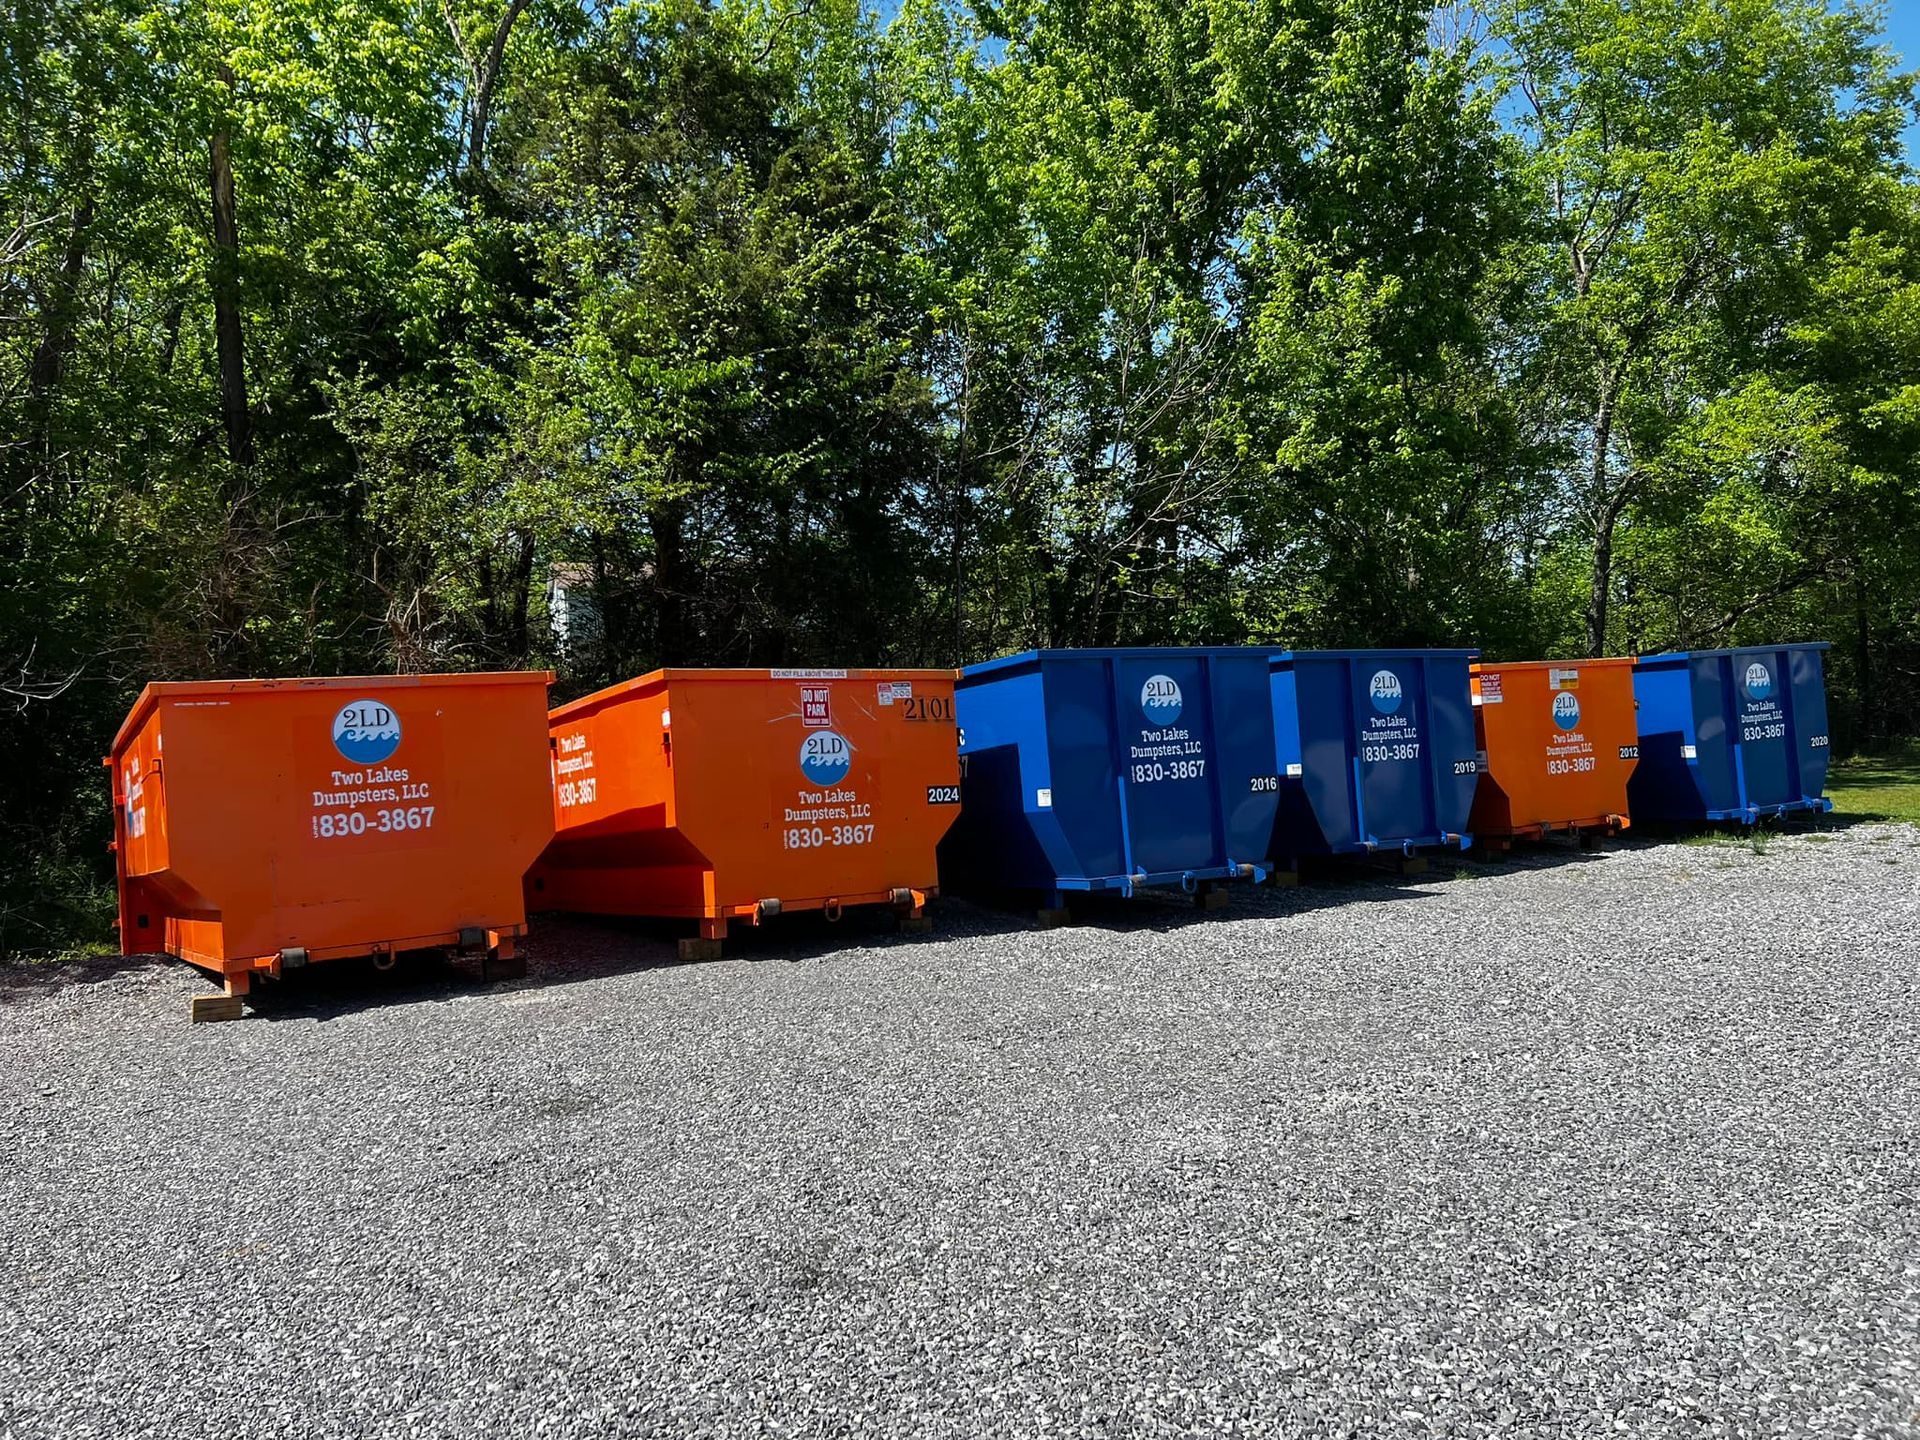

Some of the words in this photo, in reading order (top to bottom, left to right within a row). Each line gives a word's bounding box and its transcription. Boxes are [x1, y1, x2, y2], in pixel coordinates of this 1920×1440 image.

[1749, 667, 1766, 679] 2LD
[1146, 681, 1176, 696] 2LD
[1374, 676, 1397, 689] 2LD
[803, 690, 813, 702] DO
[814, 690, 828, 702] NOT
[1556, 697, 1575, 709] 2LD
[807, 703, 826, 717] PARK
[904, 698, 954, 720] 2101
[1747, 703, 1759, 712] Two
[1759, 701, 1775, 711] Lakes
[343, 708, 390, 728] 2LD
[1370, 717, 1386, 728] Two
[1387, 715, 1407, 726] Lakes
[1772, 710, 1783, 720] LLC
[1141, 730, 1161, 742] Two
[1163, 727, 1189, 741] Lakes
[1362, 729, 1403, 743] Dumpsters,
[1404, 727, 1417, 738] LLC
[1552, 734, 1566, 743] Two
[1566, 732, 1584, 742] Lakes
[1743, 724, 1785, 741] 830-3867
[807, 738, 842, 754] 2LD
[1581, 743, 1593, 752] LLC
[1810, 736, 1829, 747] 2020
[1131, 743, 1184, 760] Dumpsters,
[1185, 741, 1202, 754] LLC
[1366, 744, 1420, 762] 830-3867
[1620, 747, 1639, 758] 2012
[1136, 760, 1205, 783] 830-3867
[1454, 761, 1476, 774] 2019
[1550, 757, 1596, 774] 830-3867
[331, 771, 363, 786] Two
[366, 766, 409, 784] Lakes
[1250, 777, 1277, 791] 2016
[312, 788, 400, 808] Dumpsters,
[402, 783, 429, 799] LLC
[799, 791, 822, 804] Two
[824, 788, 856, 803] Lakes
[928, 788, 959, 802] 2024
[784, 807, 849, 824] Dumpsters,
[851, 804, 870, 817] LLC
[320, 806, 435, 838] 830-3867
[789, 824, 875, 848] 830-3867
